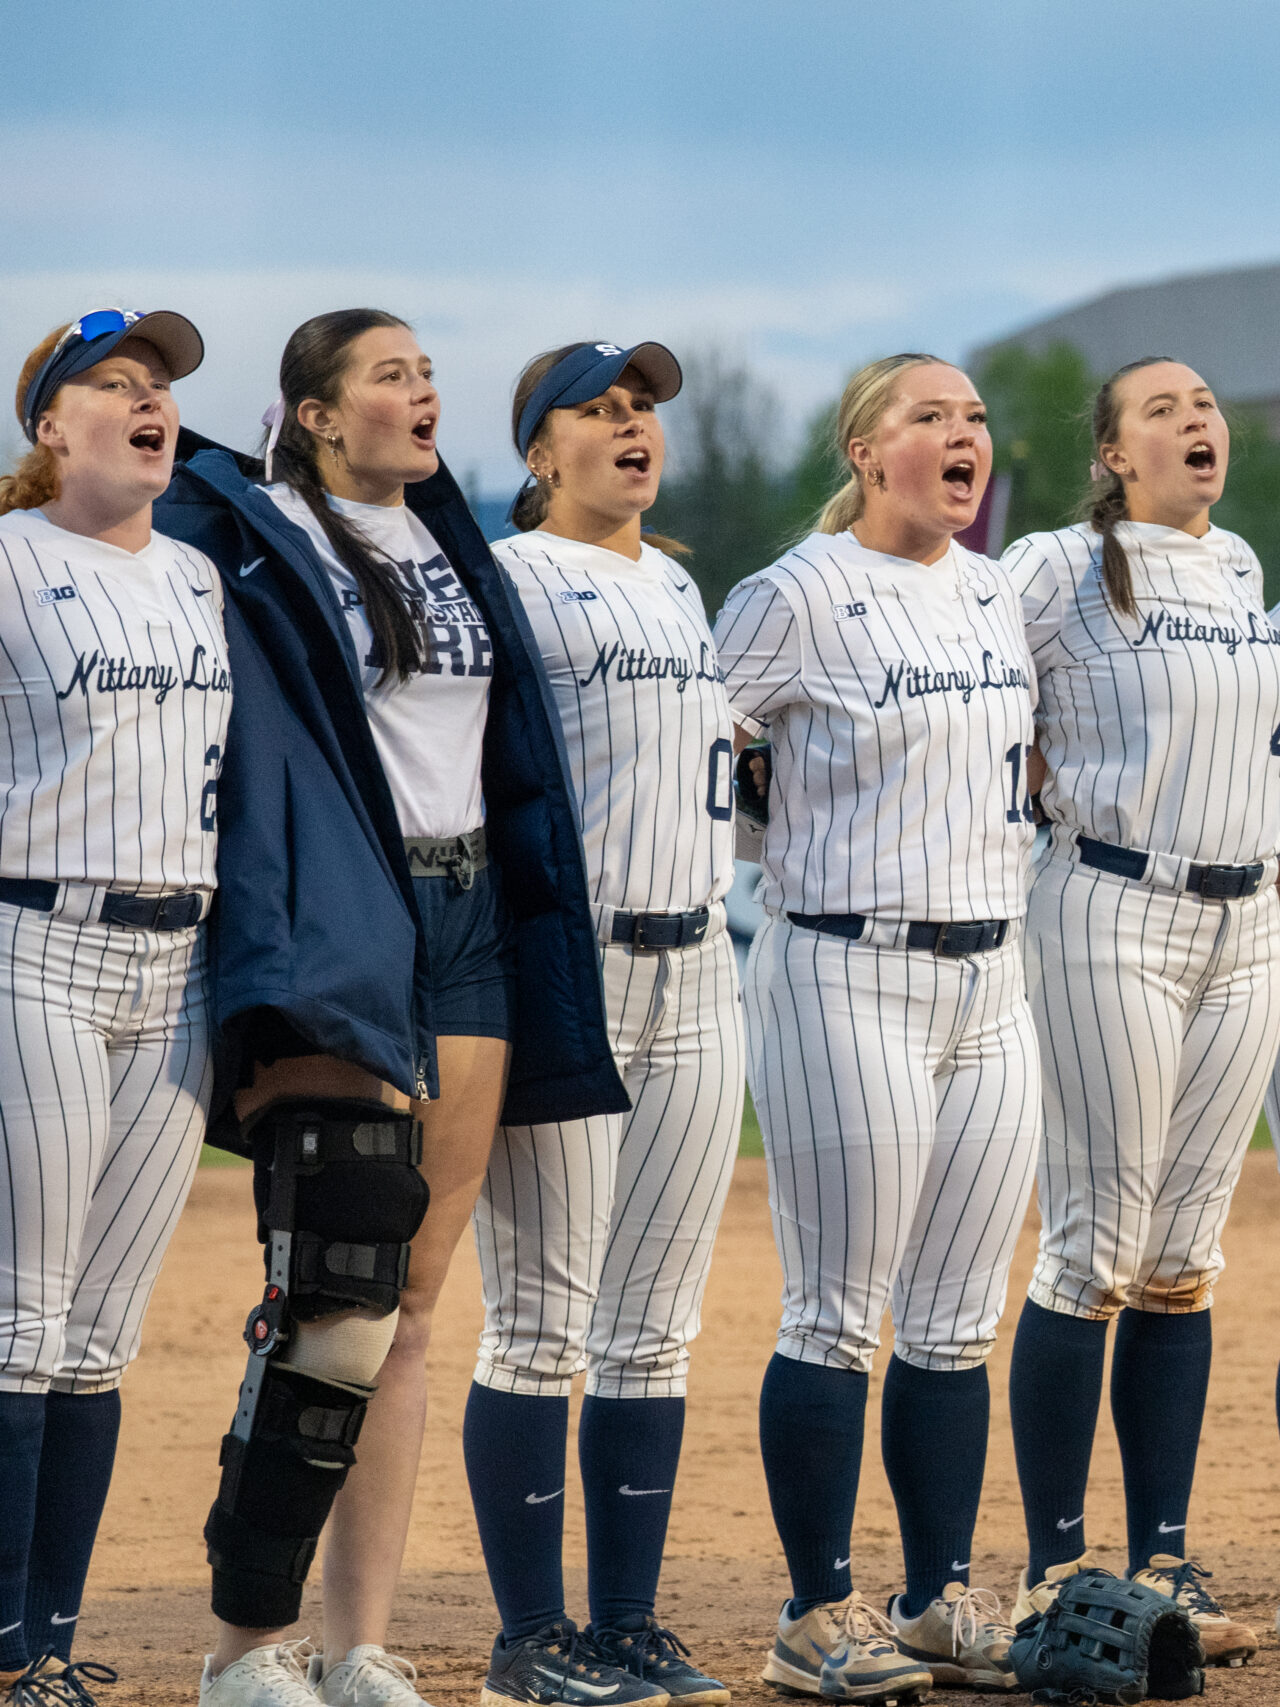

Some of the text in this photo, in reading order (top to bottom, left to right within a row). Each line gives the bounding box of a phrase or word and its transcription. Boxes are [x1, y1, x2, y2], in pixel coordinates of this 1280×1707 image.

[1133, 610, 1242, 655] Nittany
[57, 650, 177, 703] Nittany
[580, 642, 693, 692] Nittany
[874, 659, 976, 709] Nittany
[706, 738, 734, 822] 0
